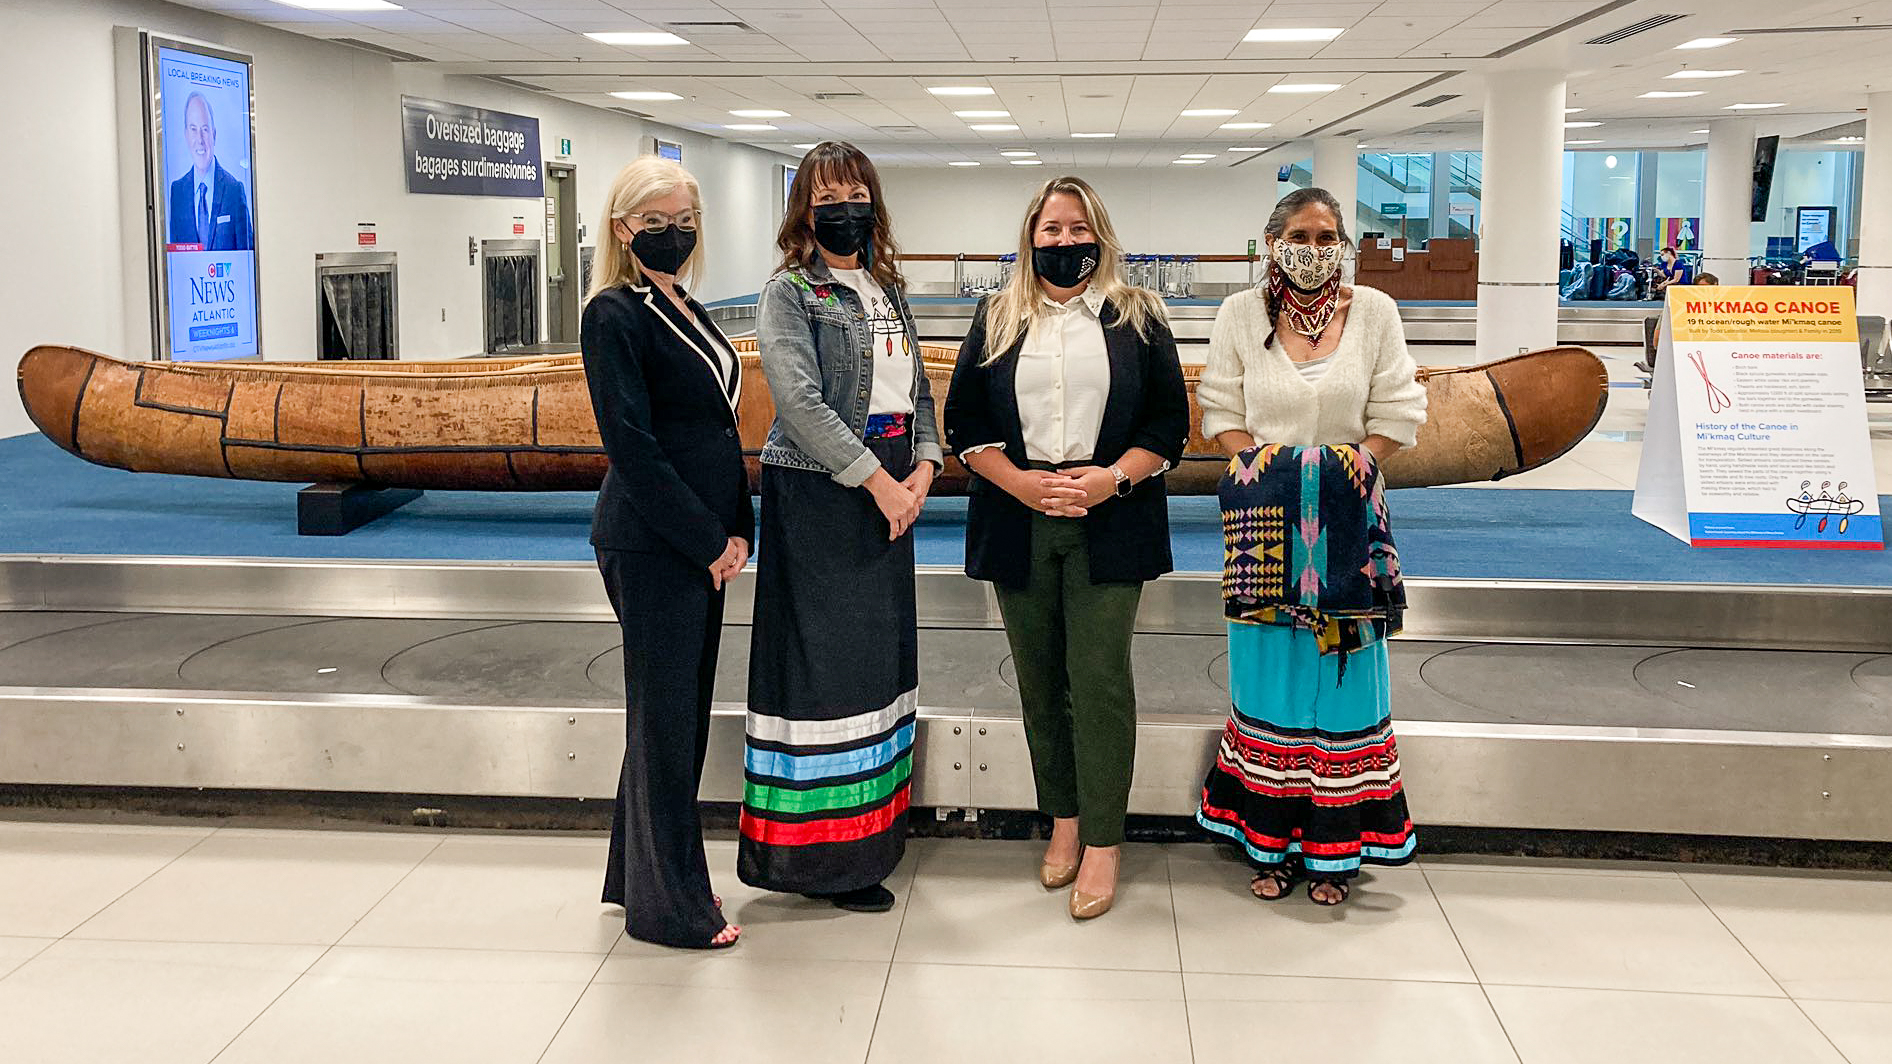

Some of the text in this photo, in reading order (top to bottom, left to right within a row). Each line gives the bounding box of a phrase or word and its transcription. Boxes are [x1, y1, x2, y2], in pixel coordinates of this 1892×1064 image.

[168, 67, 240, 88] LOCAL BREAKING NEWS
[426, 113, 525, 155] Oversized baggage
[415, 150, 537, 182] bagages surdimensionnés
[1686, 301, 1841, 314] MI'KMAQ CANOE
[193, 308, 235, 323] ATLANTIC
[1706, 318, 1756, 326] ocean/rough
[1731, 351, 1823, 360] Canoe materials are:
[1696, 423, 1728, 432] History
[1759, 423, 1788, 431] Canoe
[1790, 423, 1798, 431] in
